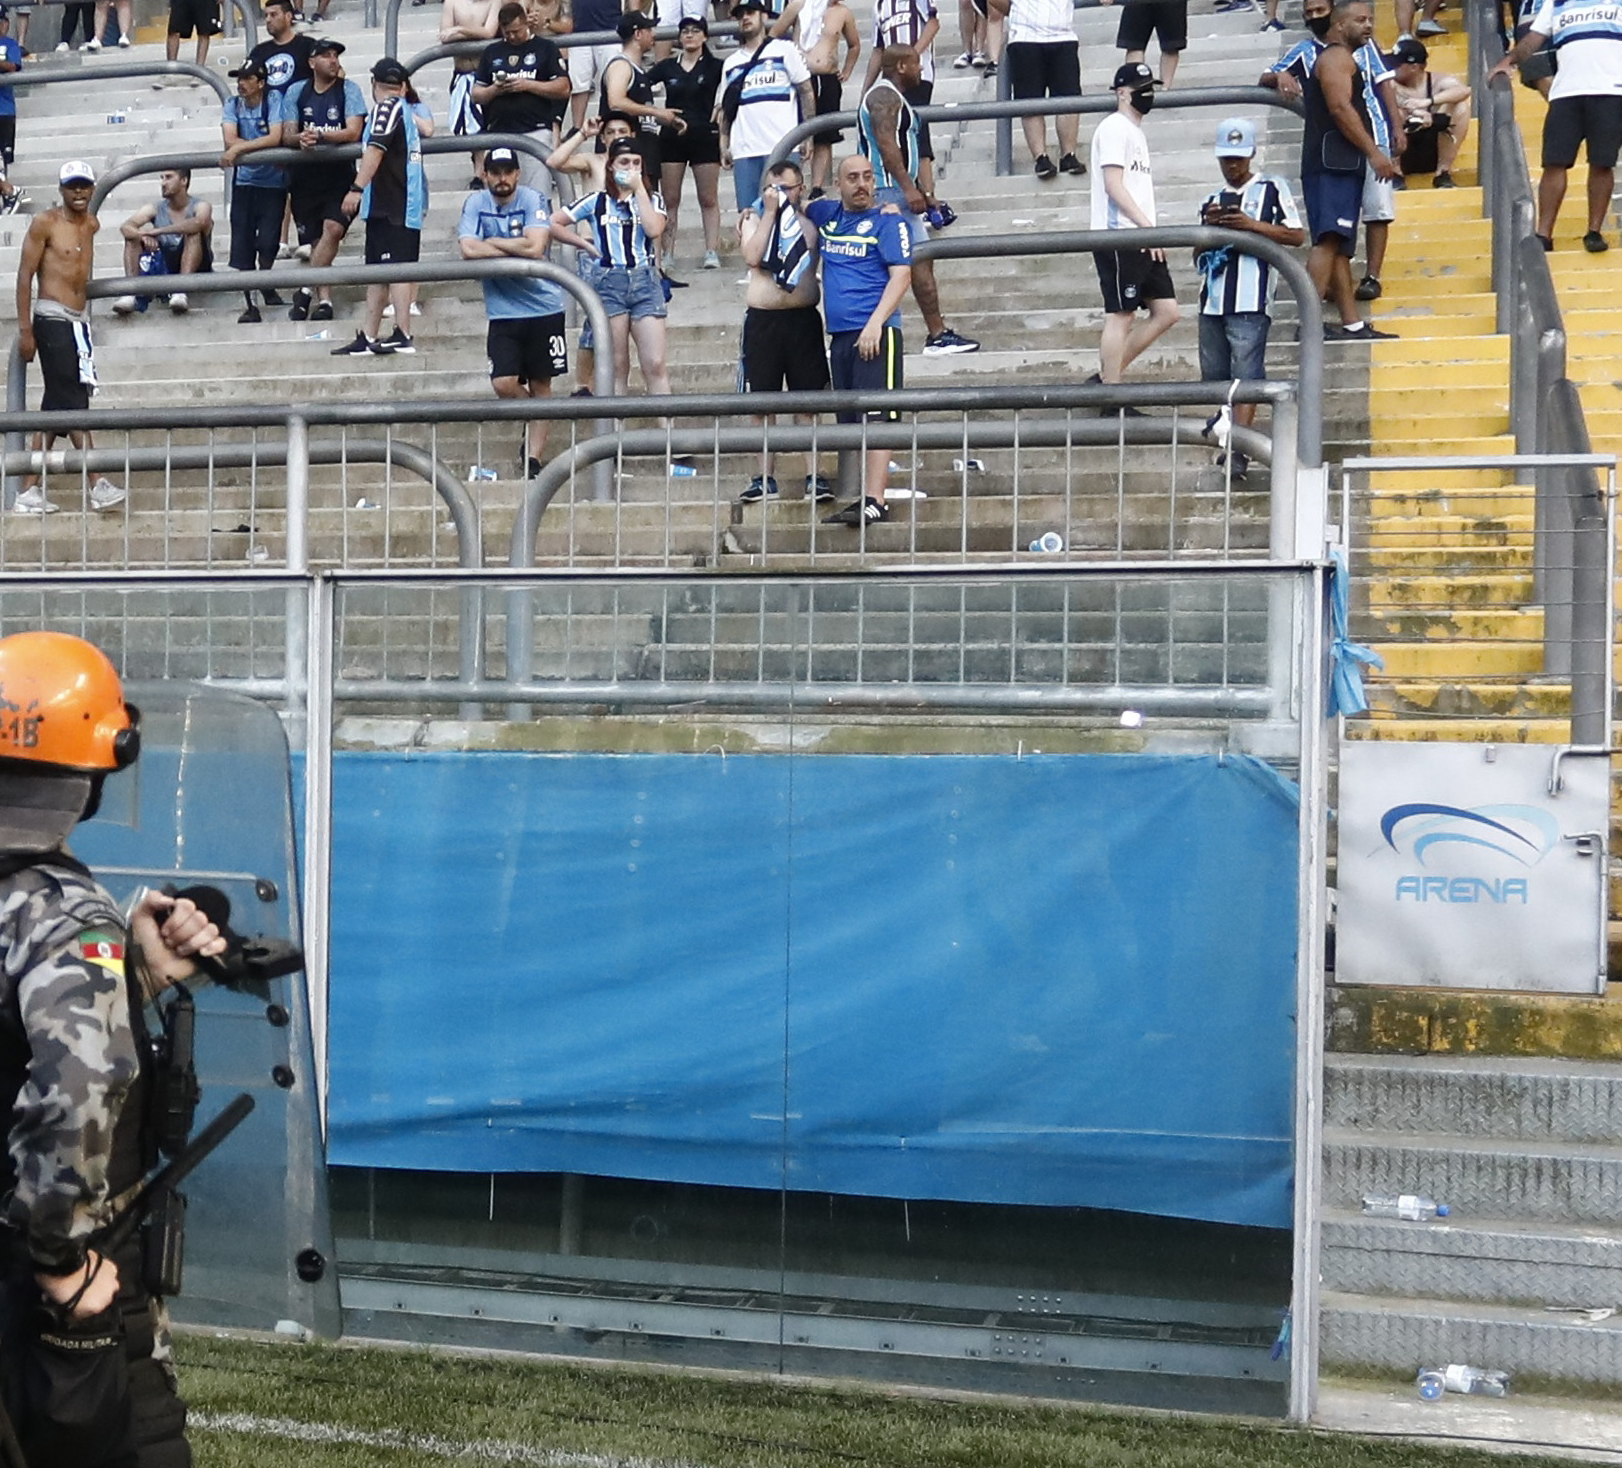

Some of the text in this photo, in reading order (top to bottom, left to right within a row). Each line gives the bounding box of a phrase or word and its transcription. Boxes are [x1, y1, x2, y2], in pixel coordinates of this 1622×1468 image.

[1560, 7, 1619, 29] Banrisul
[825, 239, 867, 257] Banrisul
[549, 335, 564, 356] 30
[1395, 875, 1528, 905] ARENA
